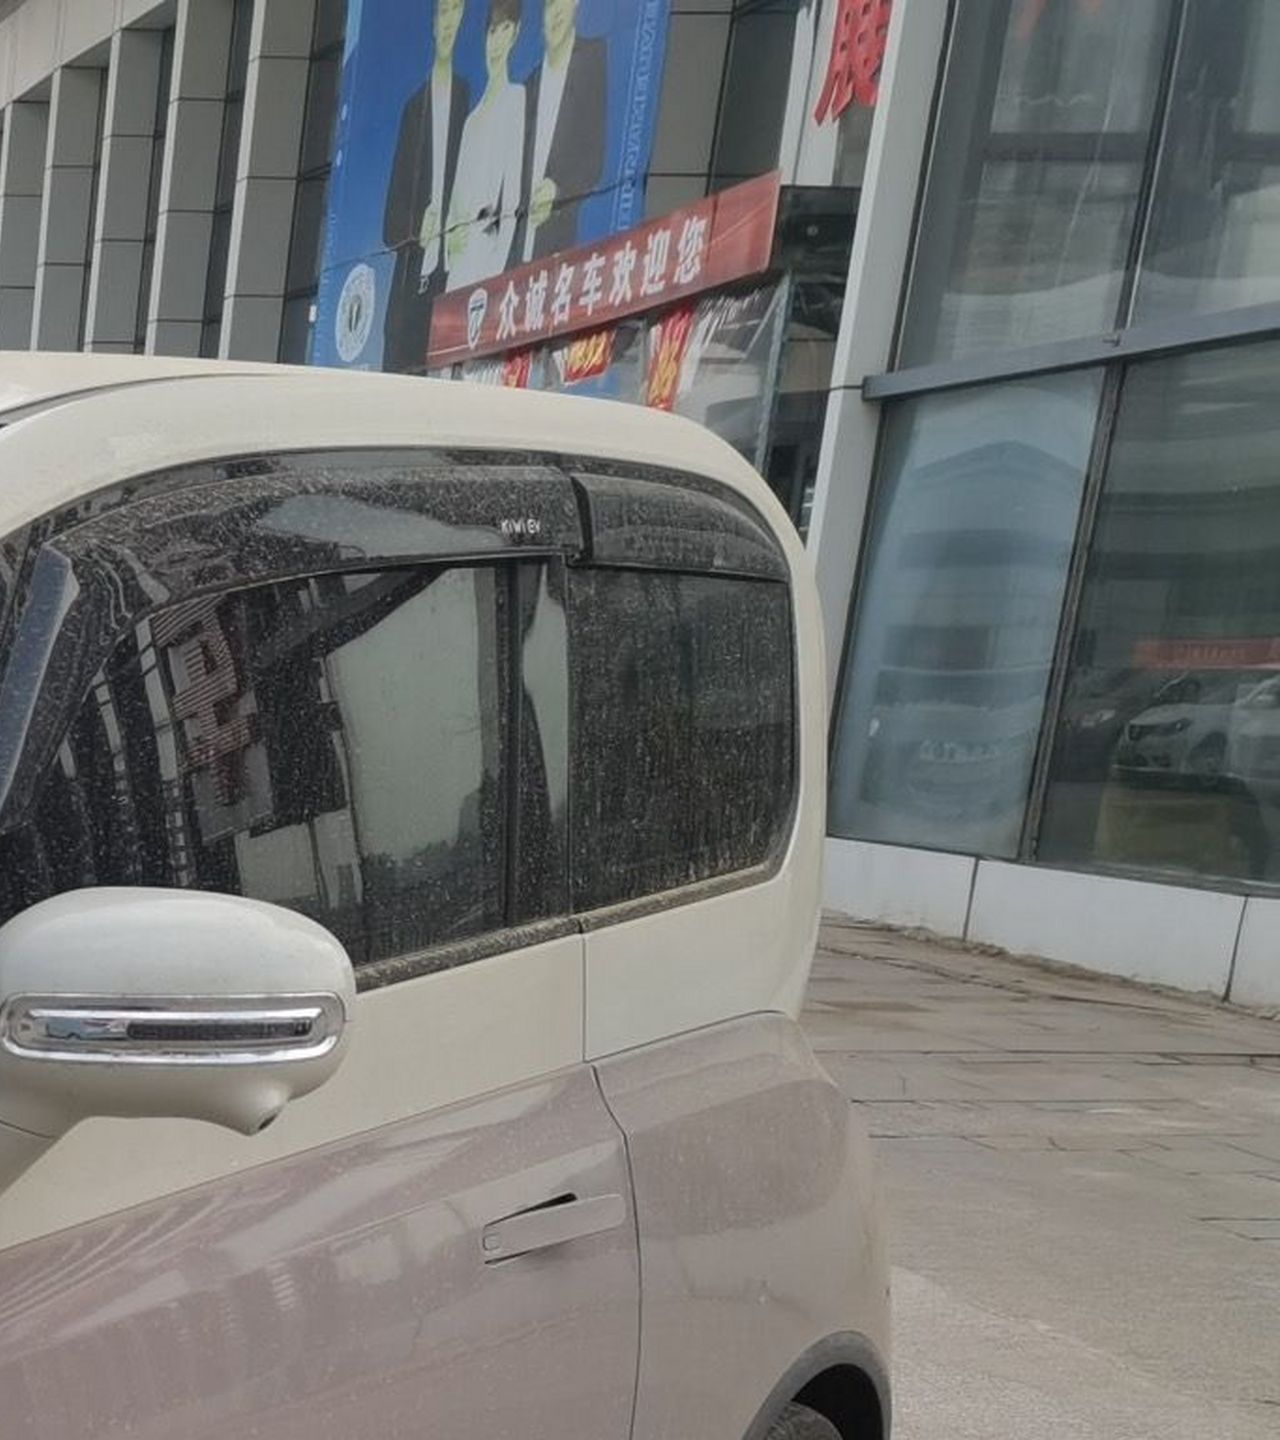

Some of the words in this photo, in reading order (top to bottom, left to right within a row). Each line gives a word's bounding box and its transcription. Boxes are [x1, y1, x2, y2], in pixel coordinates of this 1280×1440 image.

[495, 214, 710, 341] 众诚名车欢迎您
